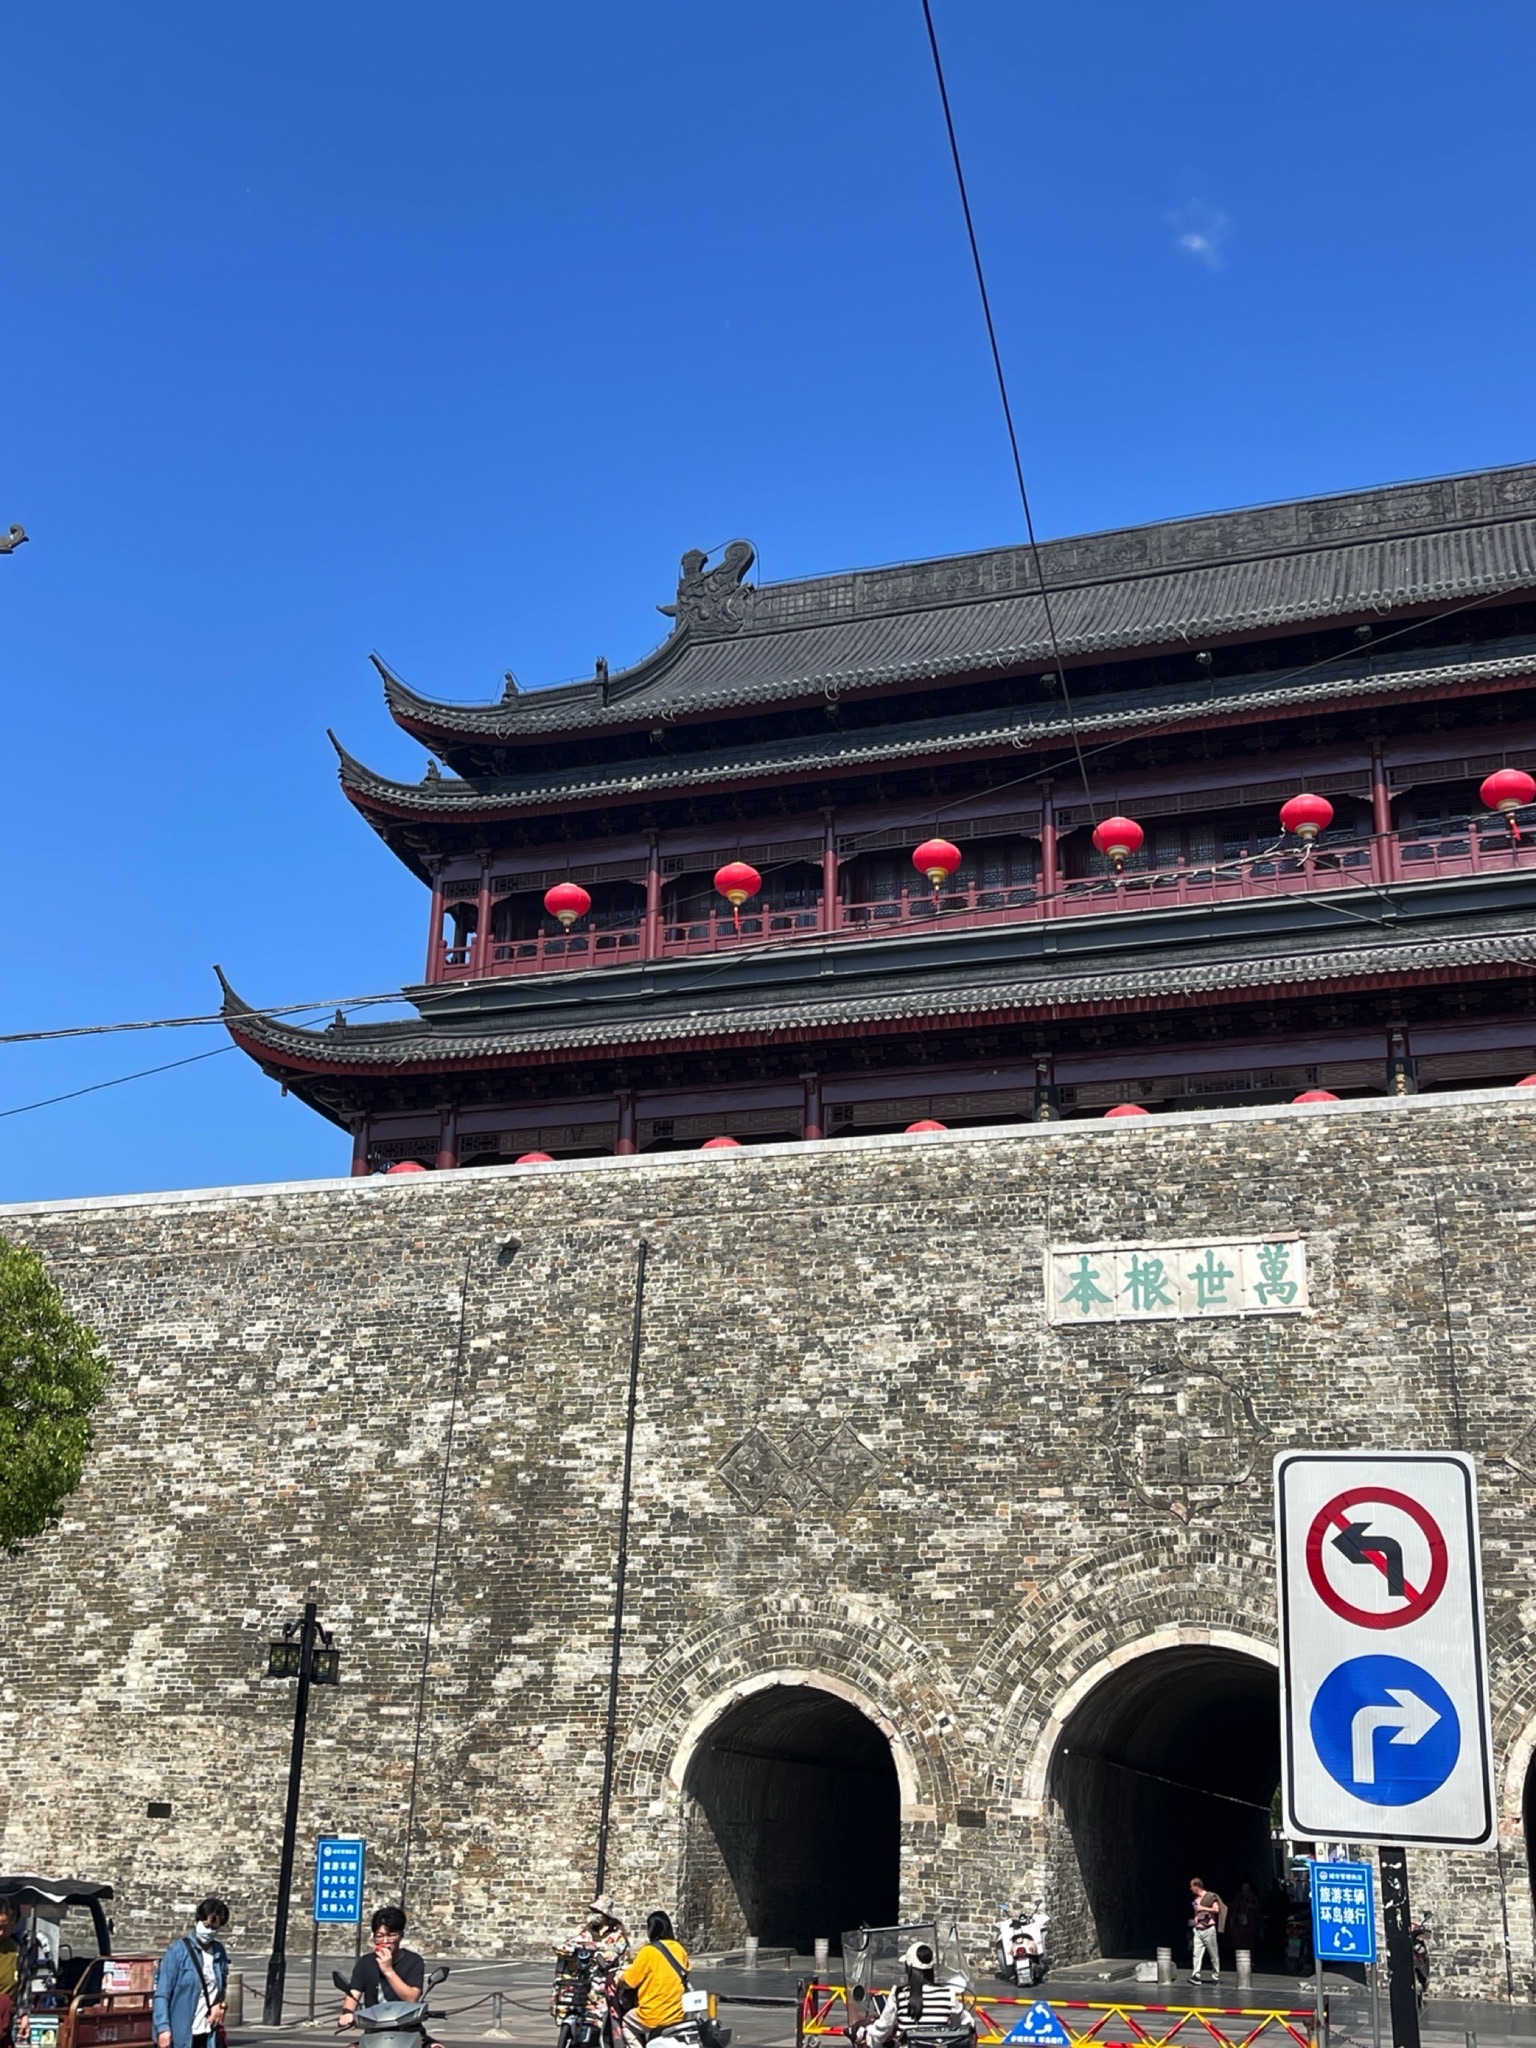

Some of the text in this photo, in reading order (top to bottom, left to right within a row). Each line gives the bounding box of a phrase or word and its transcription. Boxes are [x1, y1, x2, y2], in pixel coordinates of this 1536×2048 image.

[1319, 1886, 1366, 1906] 旅游车辆
[1320, 1906, 1367, 1925] 环岛绕行
